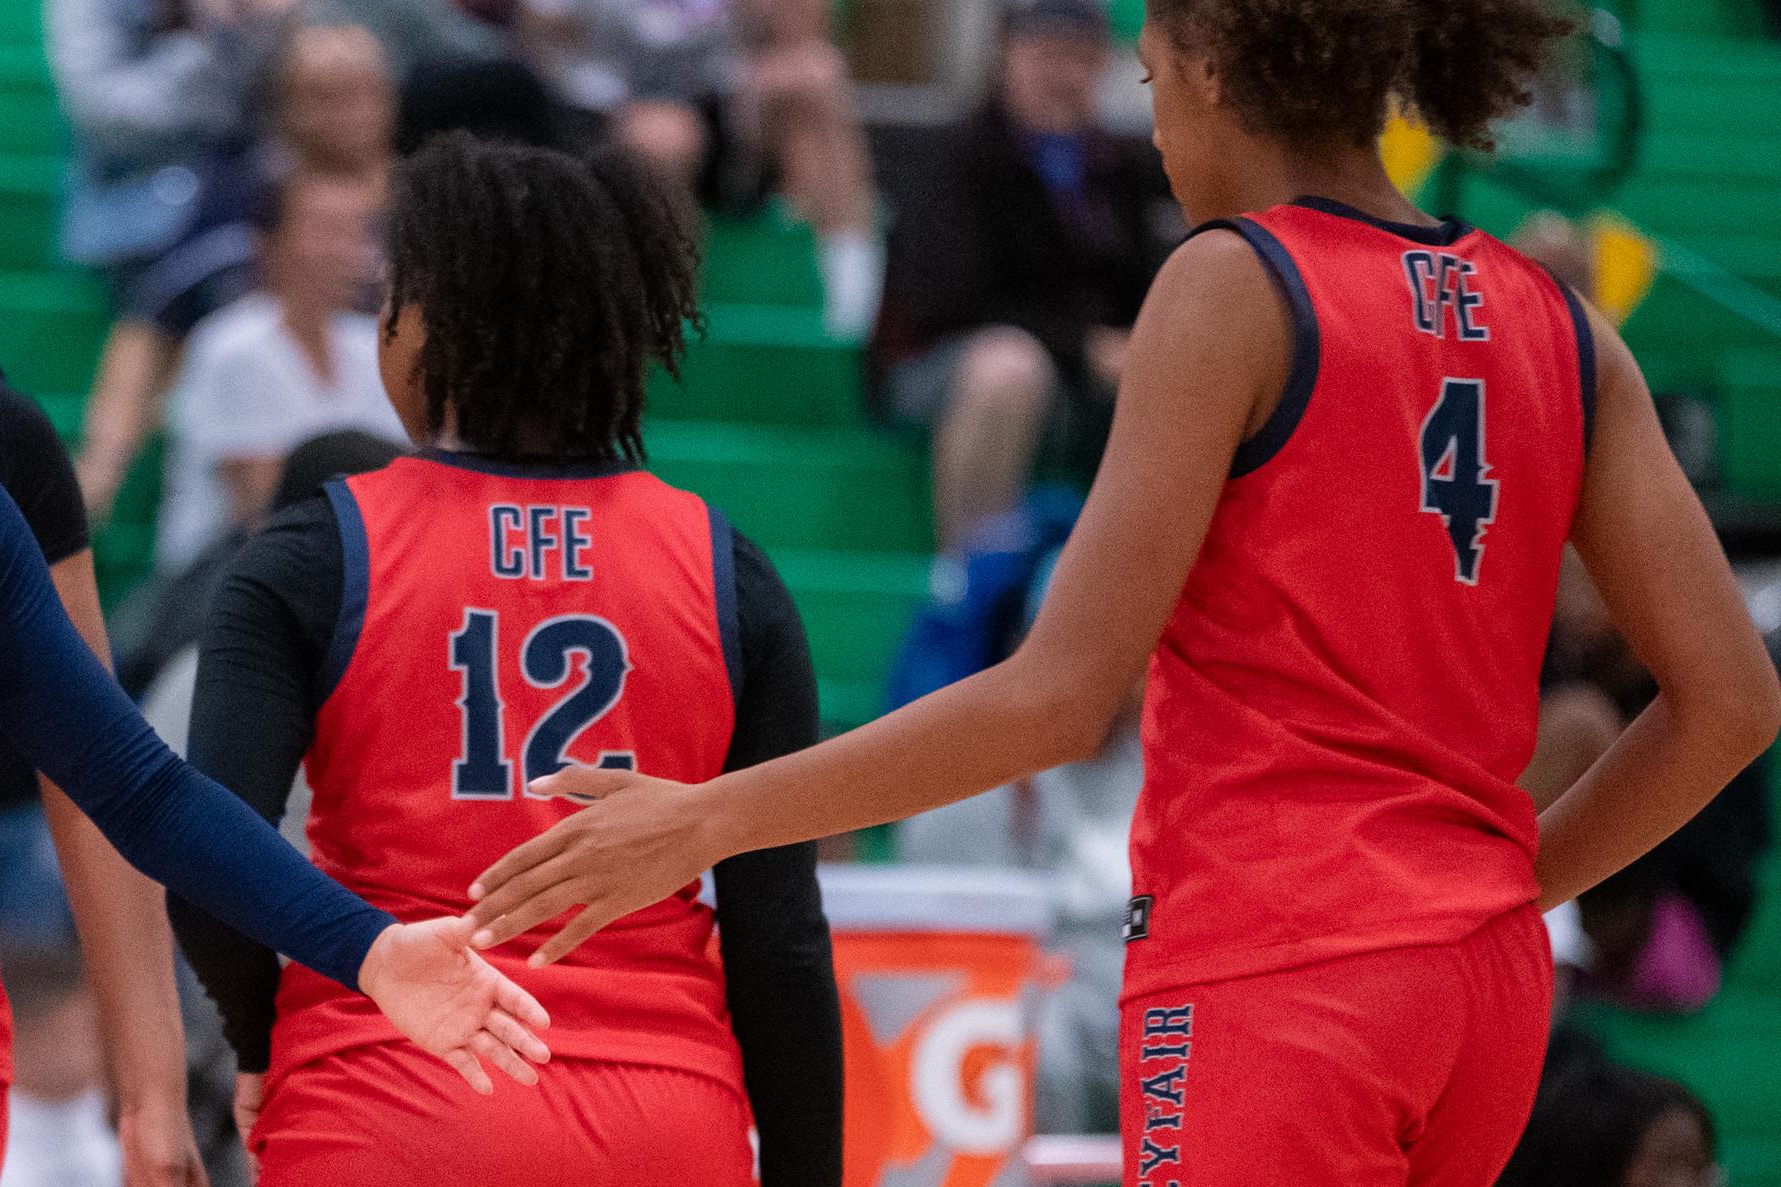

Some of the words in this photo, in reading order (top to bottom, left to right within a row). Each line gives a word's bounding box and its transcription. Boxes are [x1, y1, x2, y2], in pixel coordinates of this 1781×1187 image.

[1401, 250, 1491, 341] CFE
[488, 503, 594, 582] CFE
[1418, 376, 1501, 587] 4
[448, 606, 636, 806] 12
[912, 1000, 1023, 1150] G
